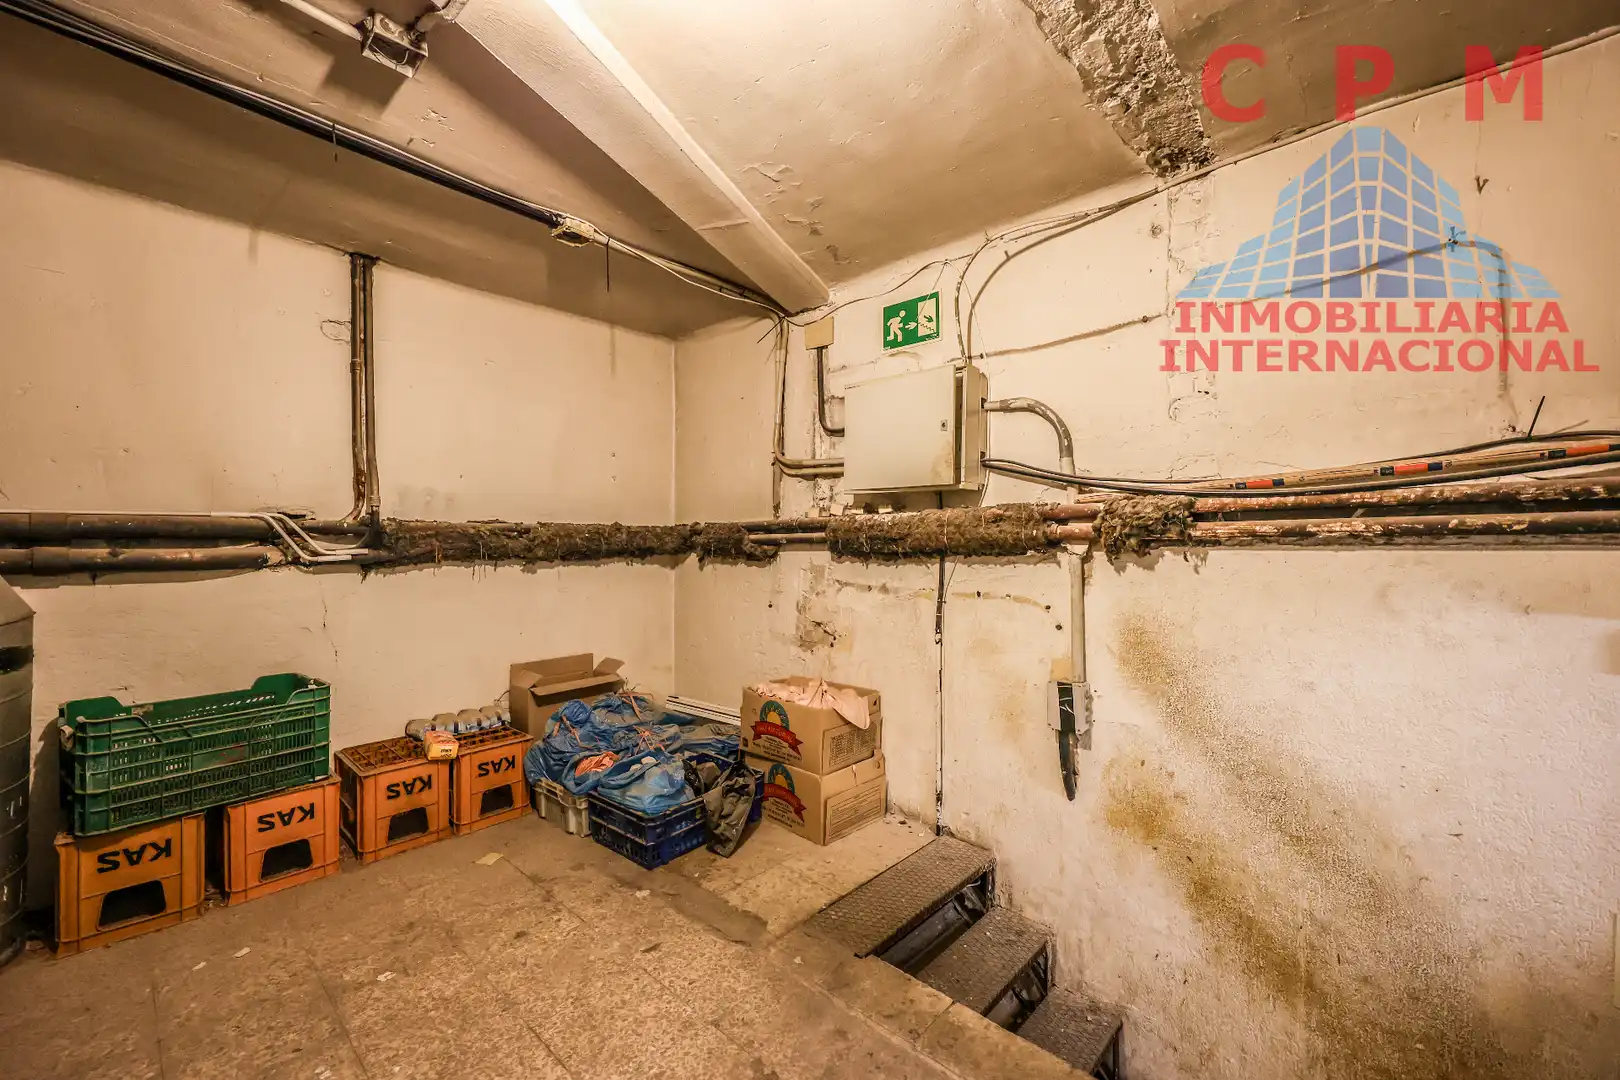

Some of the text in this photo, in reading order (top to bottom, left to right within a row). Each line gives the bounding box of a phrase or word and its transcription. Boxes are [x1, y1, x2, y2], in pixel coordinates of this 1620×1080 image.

[477, 755, 516, 778] KAS
[386, 774, 432, 800] KAS
[257, 802, 315, 833] KAS
[96, 838, 172, 875] KAS
